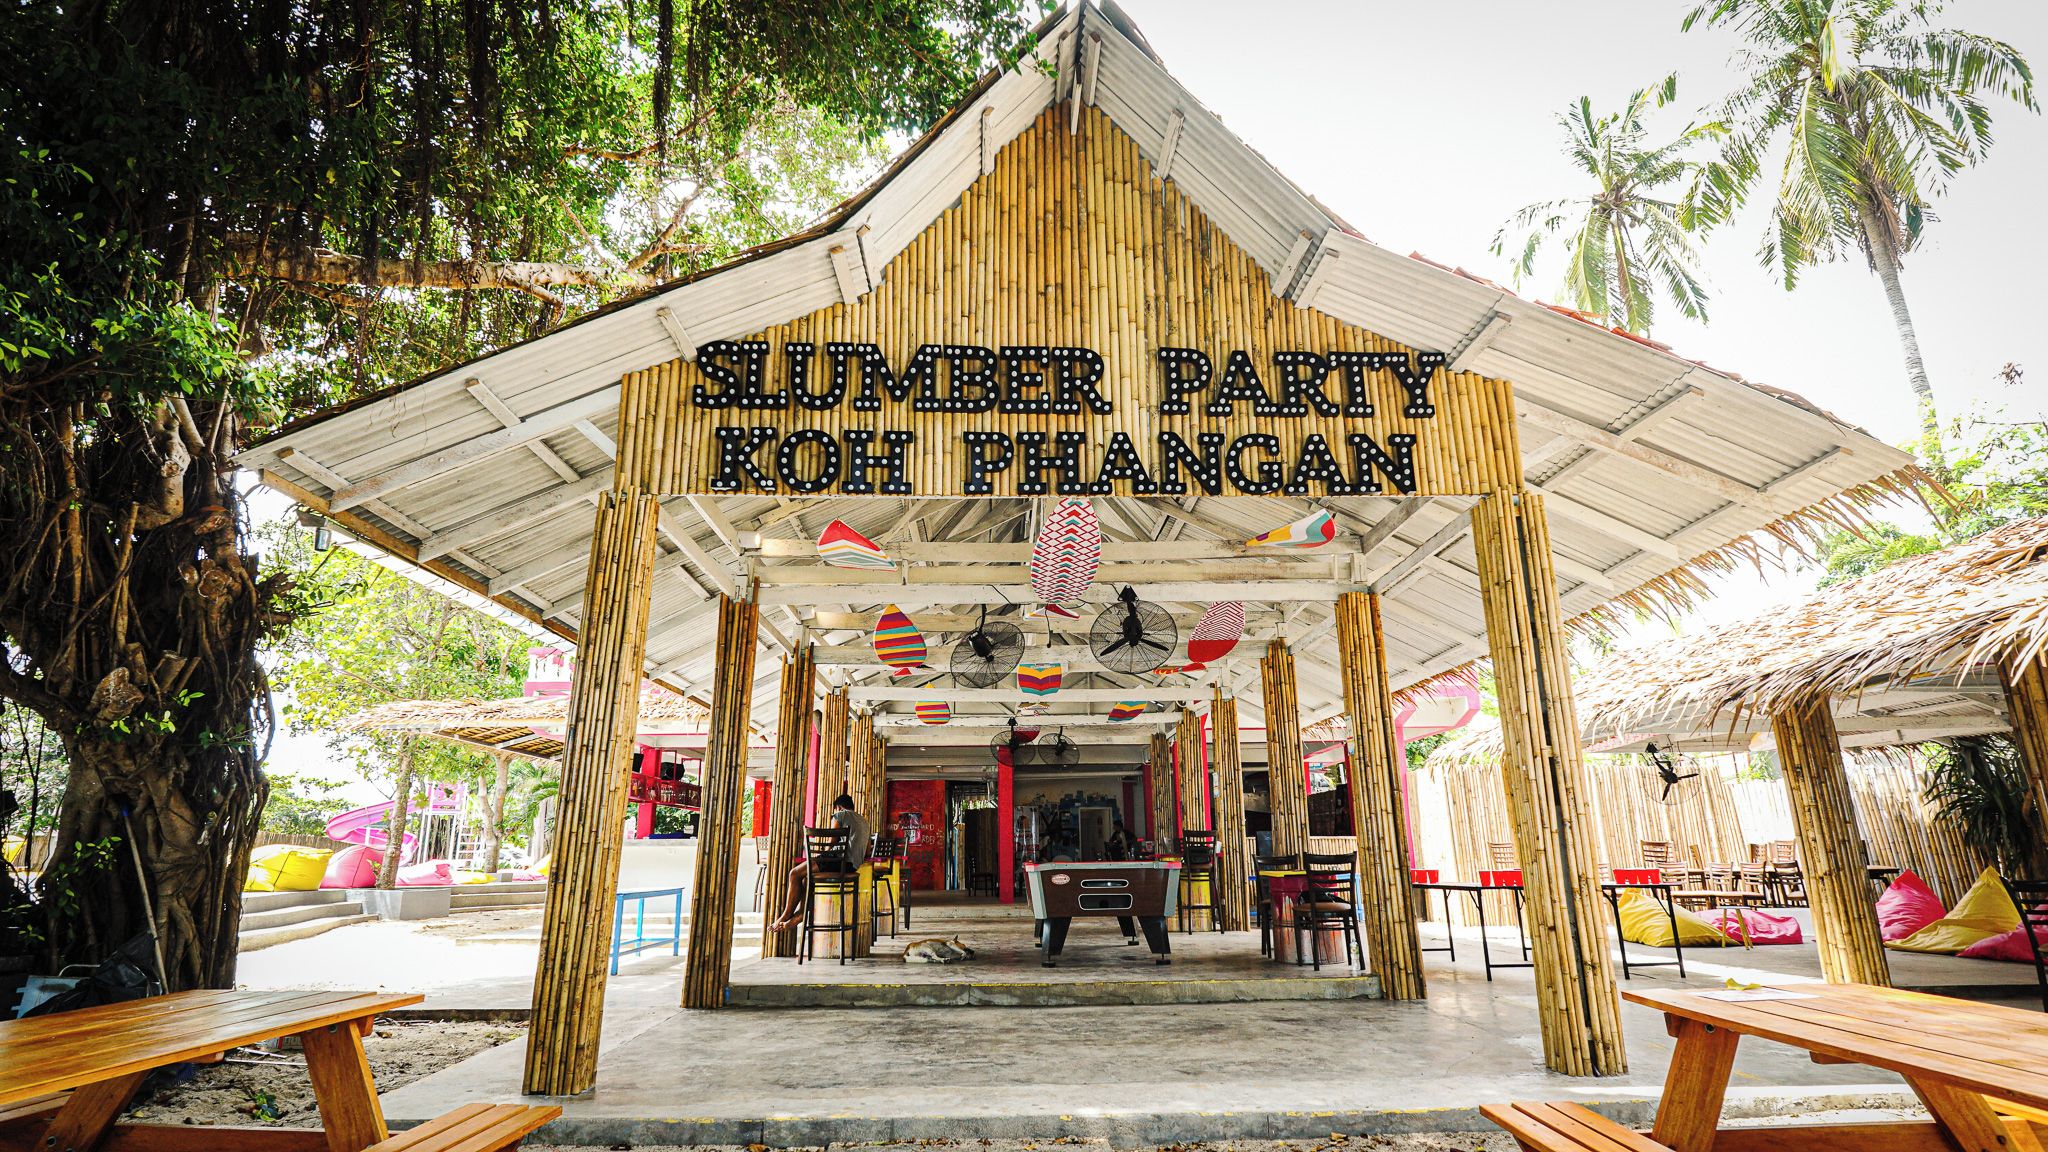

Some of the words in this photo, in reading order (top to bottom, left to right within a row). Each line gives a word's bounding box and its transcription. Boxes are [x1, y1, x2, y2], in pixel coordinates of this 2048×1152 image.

[693, 341, 1112, 414] SLUMBER
[1158, 347, 1446, 418] PARTY
[710, 426, 913, 495] KOH
[962, 430, 1418, 496] PHANGAN
